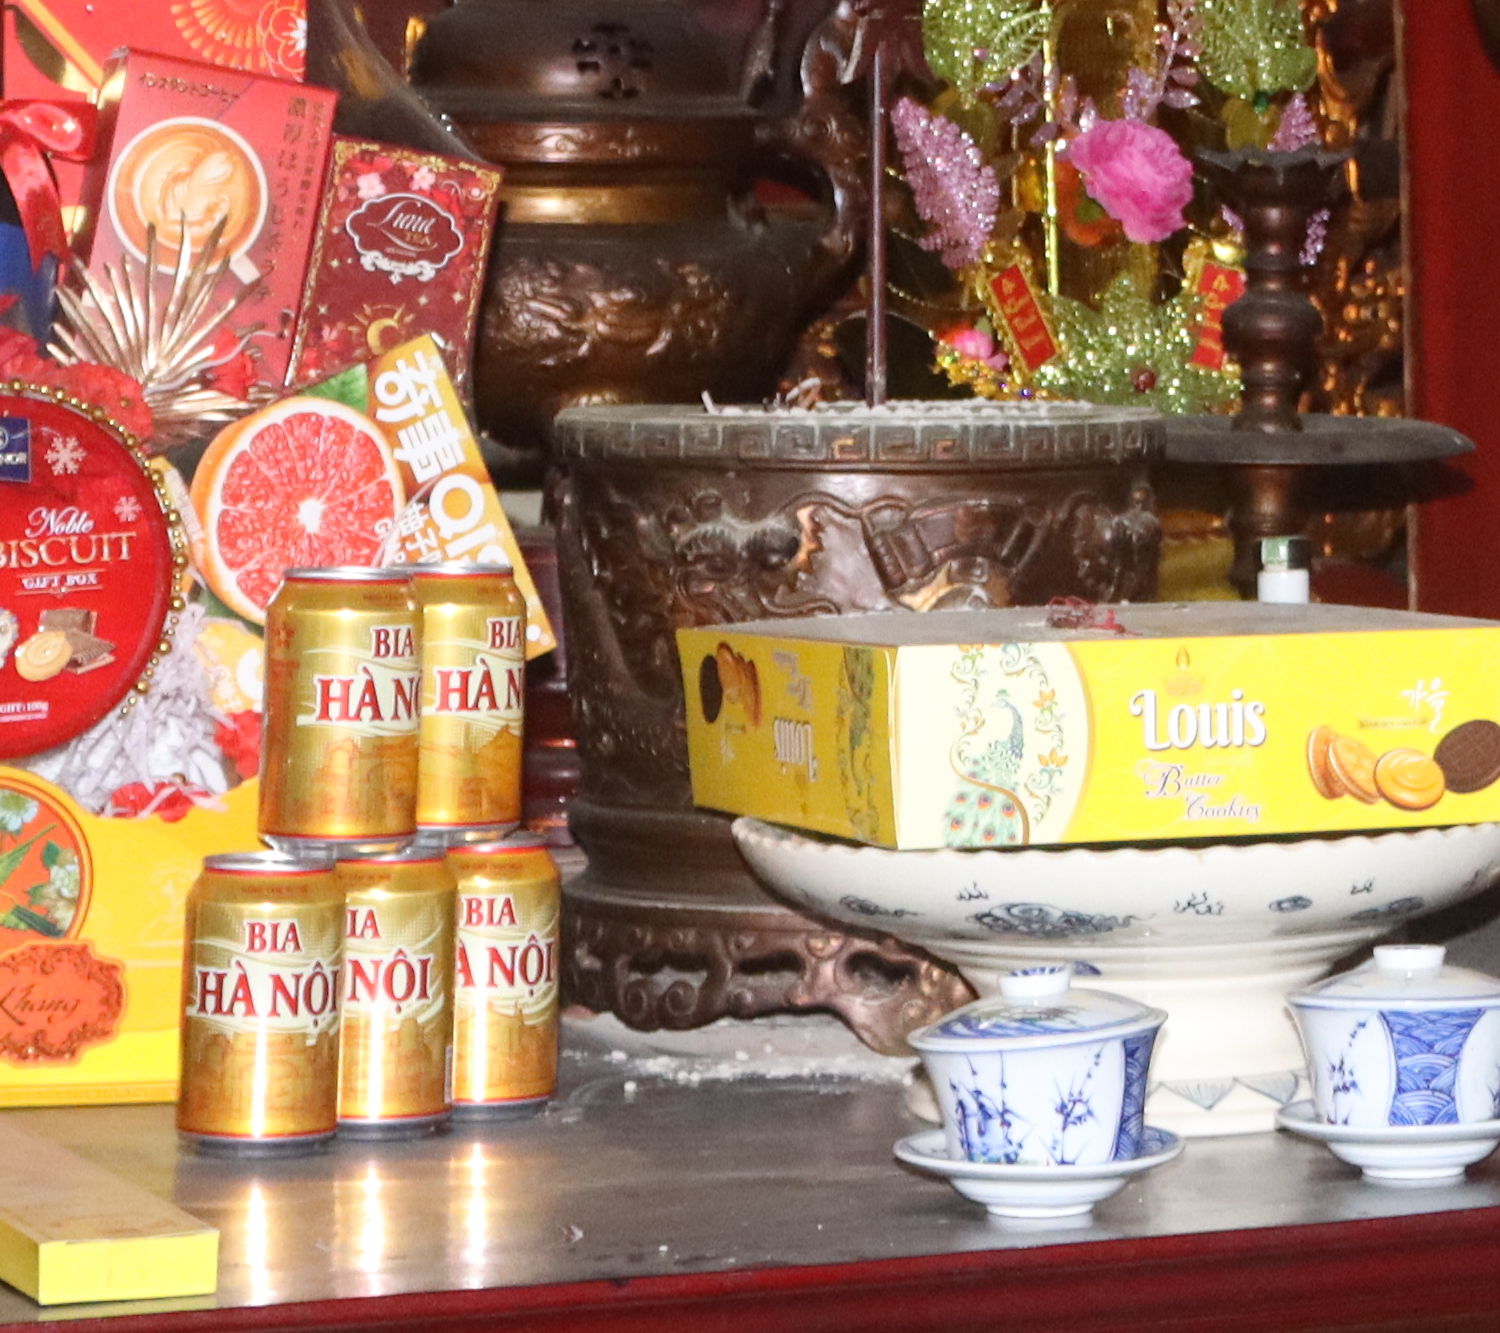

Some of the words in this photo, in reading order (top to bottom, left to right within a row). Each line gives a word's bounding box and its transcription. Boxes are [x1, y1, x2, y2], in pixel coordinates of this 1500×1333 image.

[23, 506, 96, 538] Noble
[22, 576, 59, 589] GIFT
[66, 573, 98, 587] BOX
[373, 627, 414, 659] BIA
[316, 666, 385, 722] HÀ
[435, 659, 498, 711] HÀ
[1129, 688, 1267, 751] Louis
[1134, 760, 1224, 798] Butter
[1183, 794, 1263, 823] Cookies
[346, 910, 381, 939] IA
[464, 897, 517, 926] BIA
[245, 921, 304, 954] BIA
[347, 949, 432, 1014] NỘI
[485, 933, 554, 997] NỘI
[197, 960, 259, 1016] HÀ
[268, 961, 339, 1026] NỘI
